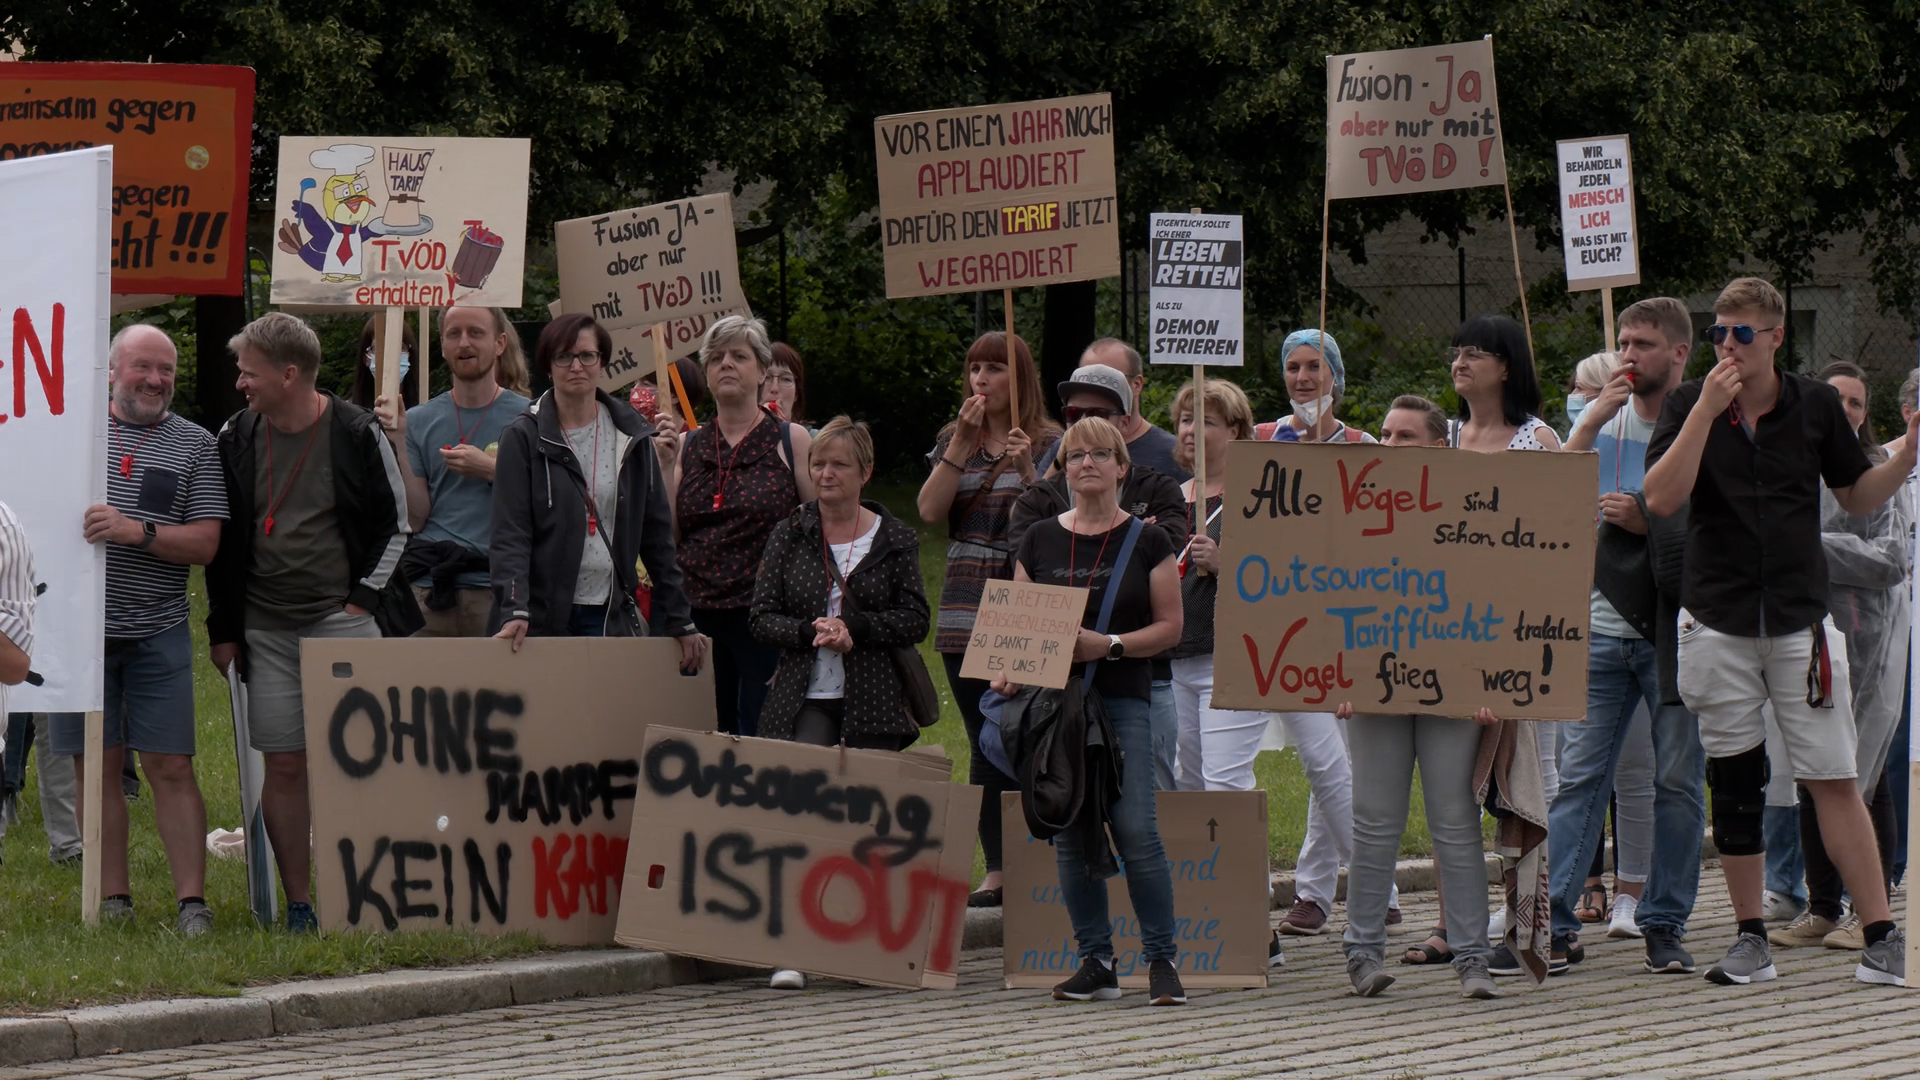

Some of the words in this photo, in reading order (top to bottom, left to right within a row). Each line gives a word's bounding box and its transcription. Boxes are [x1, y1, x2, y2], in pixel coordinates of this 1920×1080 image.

[1337, 58, 1412, 102] Fusion
[1429, 55, 1481, 115] Ja
[105, 98, 196, 135] gegen
[881, 121, 931, 157] VOR
[936, 114, 1005, 151] EINEM
[1008, 107, 1064, 145] JAHR
[1066, 103, 1111, 137] NOCH
[1340, 111, 1389, 137] aber
[1396, 119, 1433, 137] nur
[1443, 107, 1495, 137] mit
[388, 151, 431, 172] HAUS
[1566, 158, 1622, 173] BEHANDELN
[1582, 145, 1603, 158] WIR
[390, 174, 423, 192] TARIF
[918, 149, 1085, 198] APPLAUDIERT
[1579, 173, 1611, 187] JEDEN
[112, 184, 190, 218] gegen
[1568, 188, 1624, 209] MENSCH
[592, 212, 660, 246] Fusion
[886, 210, 956, 246] DAFÜR
[962, 209, 998, 239] DEN
[1001, 203, 1058, 233] TARIF
[1062, 196, 1115, 229] JETZT
[1155, 219, 1202, 228] EIGENTLICH
[1202, 220, 1230, 229] SOLLTE
[1580, 210, 1610, 229] LICH
[1155, 230, 1170, 238] ICH
[1170, 231, 1191, 239] EHER
[1571, 235, 1591, 248] WAS
[1594, 234, 1608, 245] IST
[1610, 232, 1627, 244] MIT
[371, 238, 446, 271] TVÖD
[606, 252, 648, 276] aber
[658, 247, 686, 267] nur
[918, 243, 1077, 288] WEGRADIERT
[1157, 241, 1226, 263] LEBEN
[1581, 246, 1622, 265] EUCH?
[1155, 264, 1240, 286] RETTEN
[592, 291, 622, 320] mit
[637, 275, 693, 312] TVöD
[1155, 302, 1170, 310] ALS
[1171, 302, 1182, 310] ZU
[1155, 318, 1219, 335] DEMON
[1154, 338, 1238, 355] STRIEREN
[1243, 459, 1323, 519] Alle
[1236, 554, 1449, 613] Outsourcing
[988, 588, 1010, 606] WIR
[1014, 589, 1073, 610] RETTEN
[1325, 603, 1504, 652] Tarifflucht
[1513, 611, 1583, 642] tralala
[972, 633, 987, 648] SO
[994, 635, 1032, 651] DANKT
[1041, 640, 1059, 656] IHR
[988, 656, 1004, 670] ES
[1243, 617, 1353, 704] Vogel
[1376, 652, 1444, 705] flieg
[328, 684, 526, 779] OHNE
[484, 759, 640, 827] MAMPF
[338, 836, 512, 930] KEIN
[678, 830, 808, 938] IST
[797, 847, 970, 973] OUT
